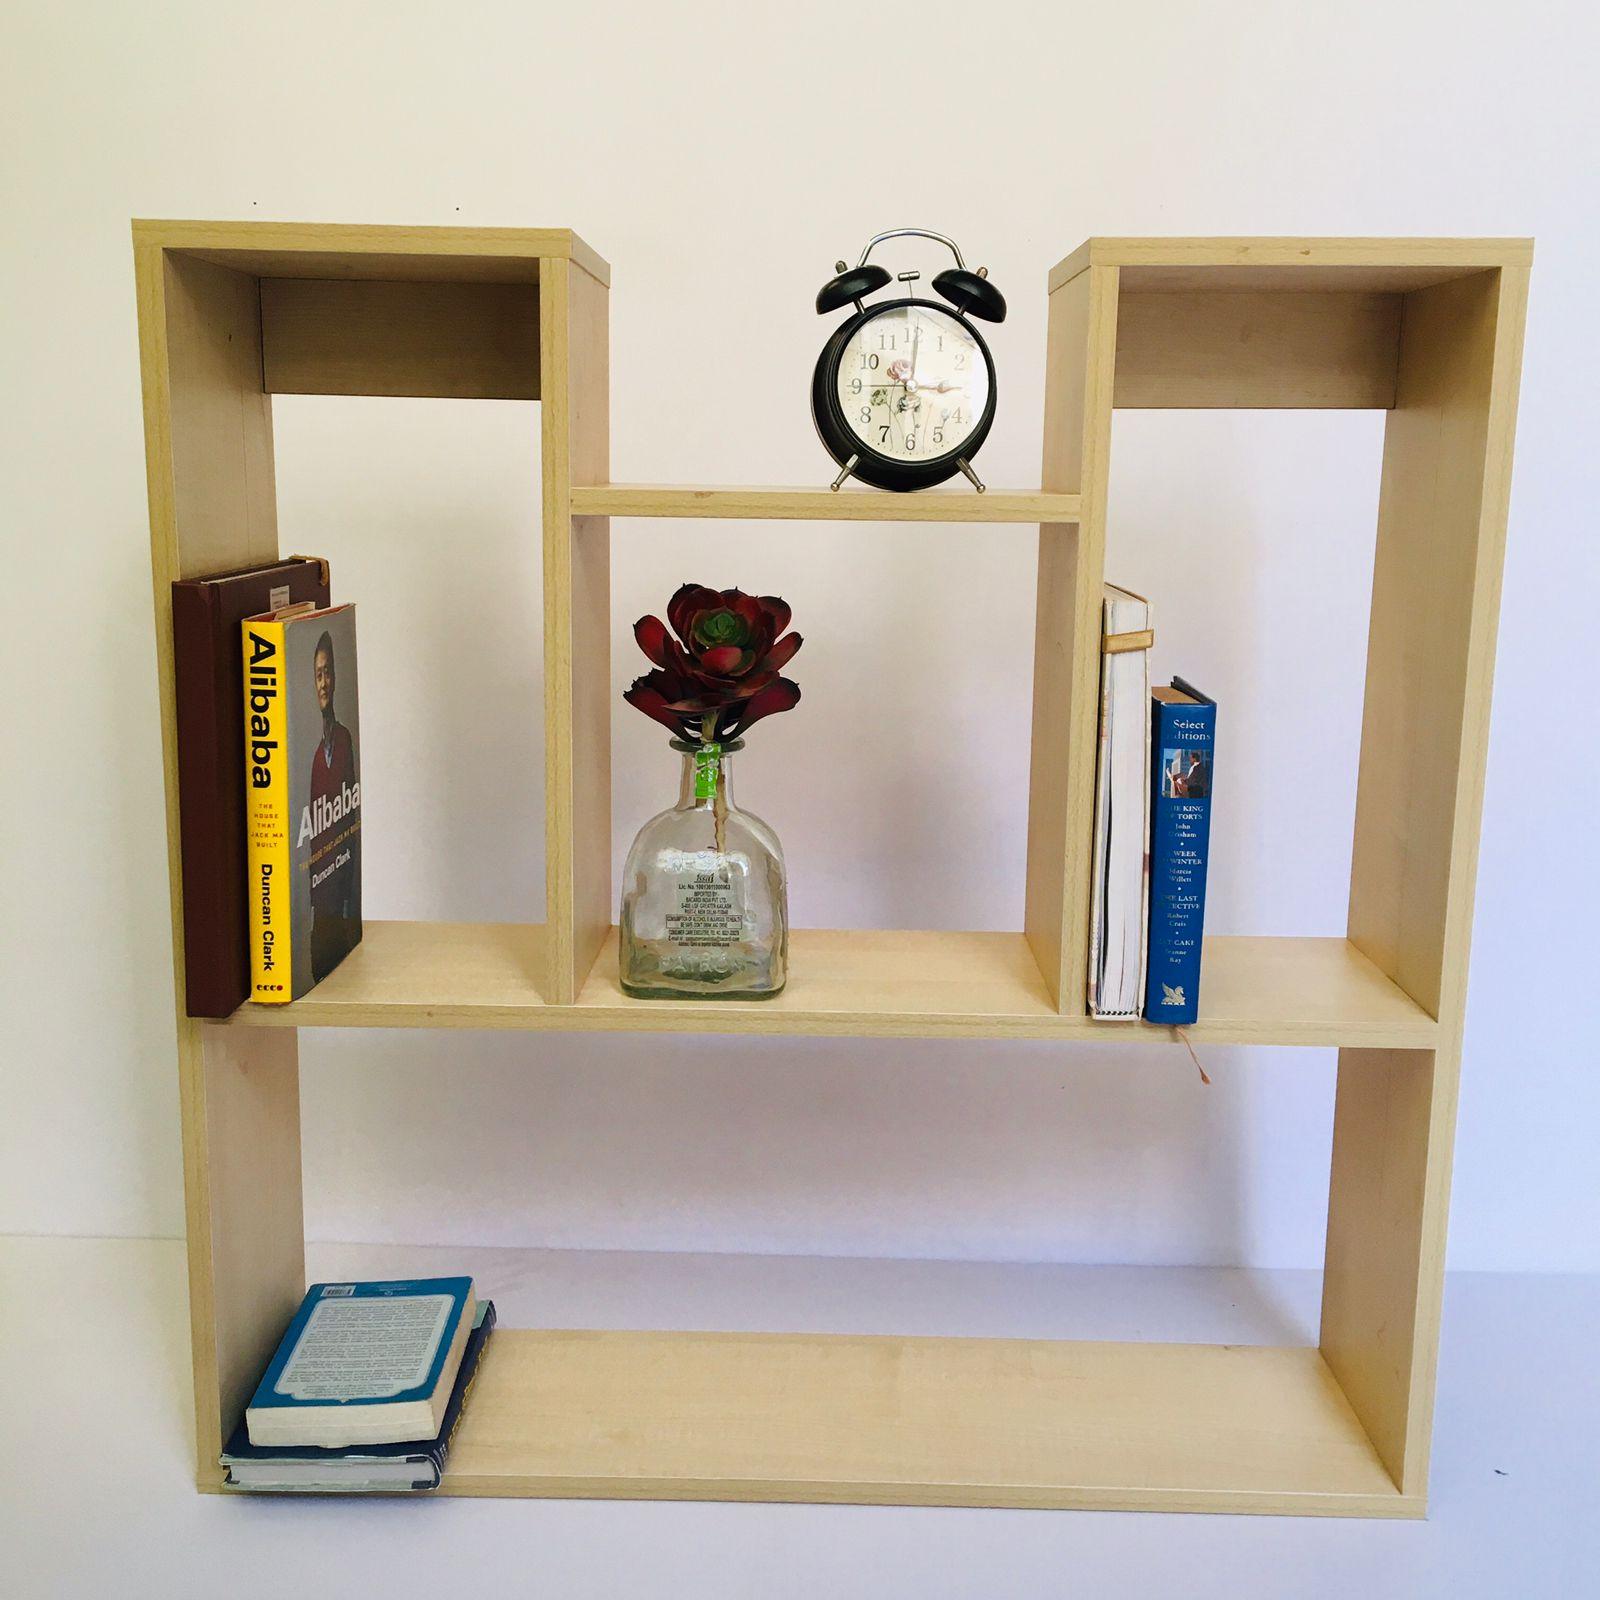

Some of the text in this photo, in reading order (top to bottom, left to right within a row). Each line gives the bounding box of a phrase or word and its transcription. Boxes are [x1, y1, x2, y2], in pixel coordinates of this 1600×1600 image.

[879, 335, 897, 350] 11
[860, 354, 879, 370] 10
[954, 354, 965, 371] 2
[851, 378, 862, 395] 9
[860, 406, 871, 424] 8
[952, 407, 963, 424] 4
[878, 425, 890, 443] 7
[905, 434, 916, 450] 6
[932, 426, 943, 443] 5
[249, 631, 278, 788] Alibaba
[1173, 719, 1205, 729] Select
[1170, 730, 1211, 740] ditions
[297, 781, 361, 848] Alibaba
[312, 849, 351, 888] Duncan Clark
[261, 864, 275, 972] Duncan Clark
